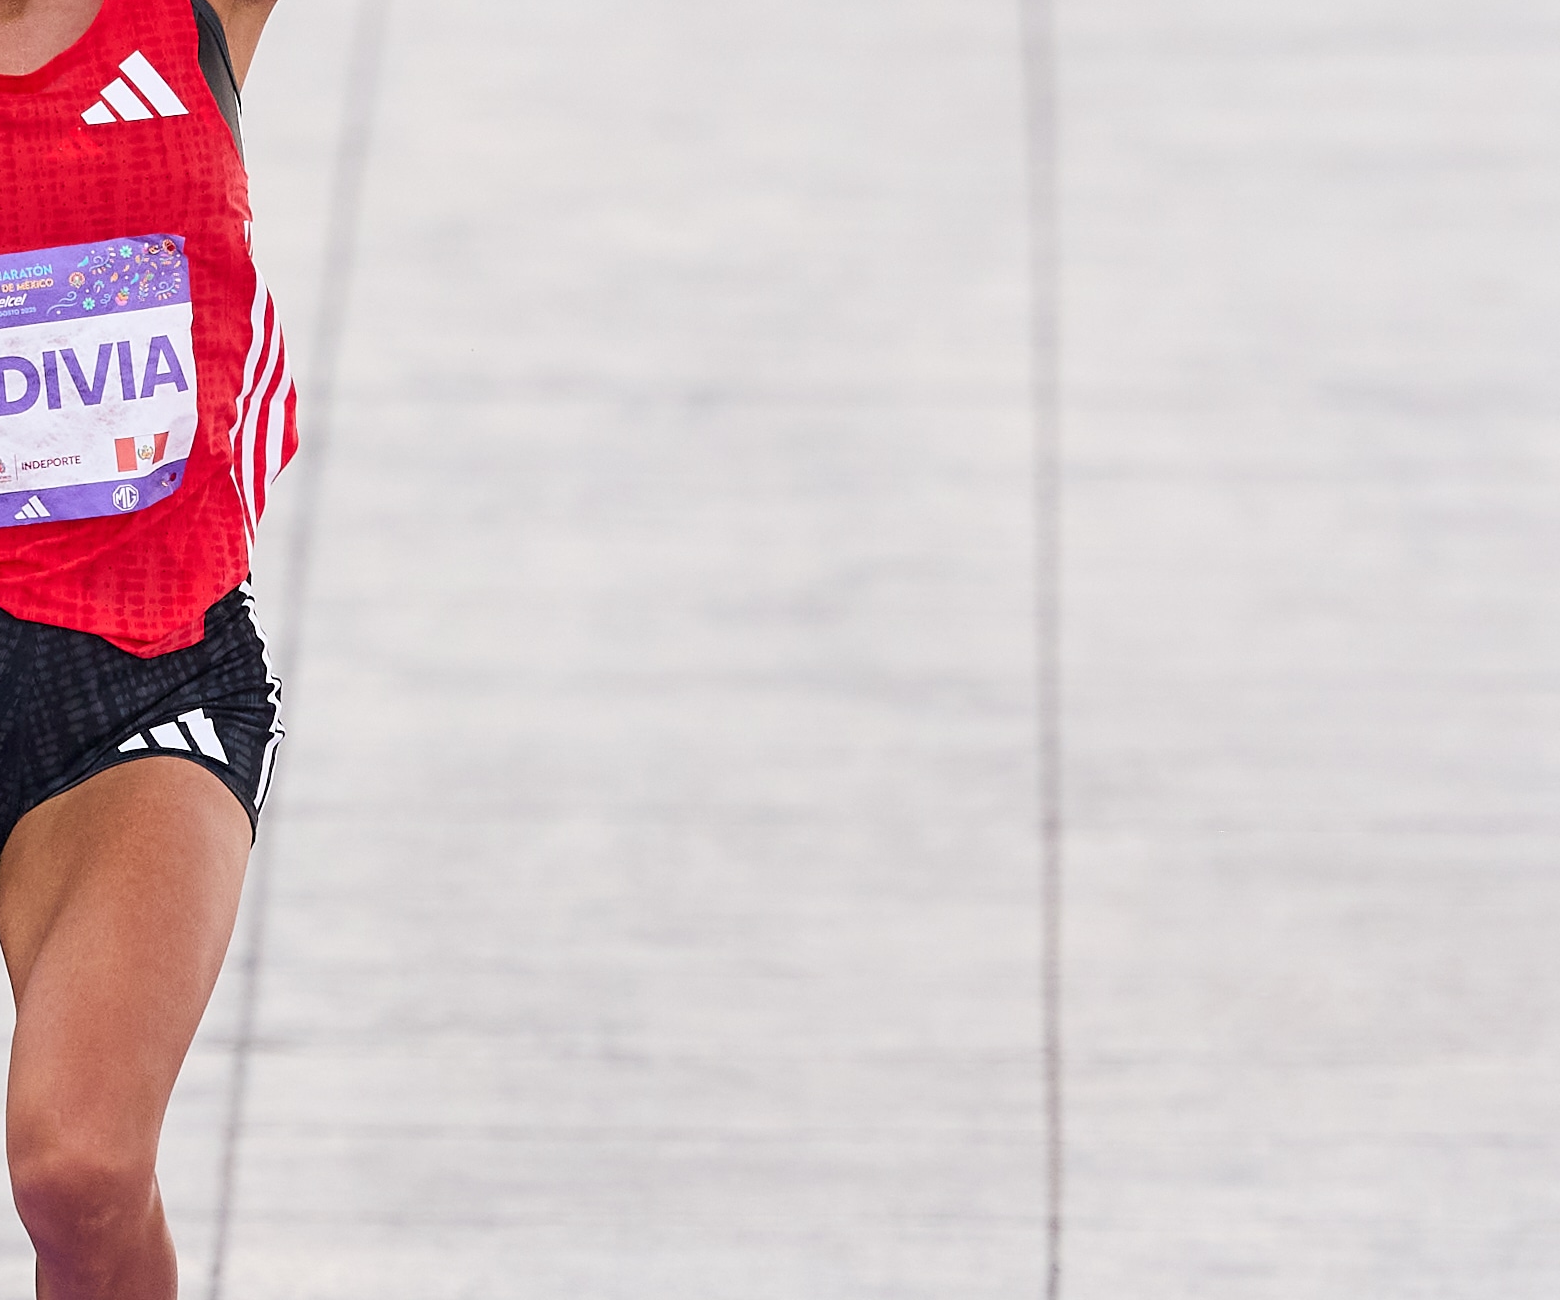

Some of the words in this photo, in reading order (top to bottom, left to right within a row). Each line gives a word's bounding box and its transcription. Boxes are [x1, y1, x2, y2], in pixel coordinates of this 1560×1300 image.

[1, 283, 15, 293] DE
[21, 455, 82, 471] INDEPORTE
[114, 485, 139, 510] MG
